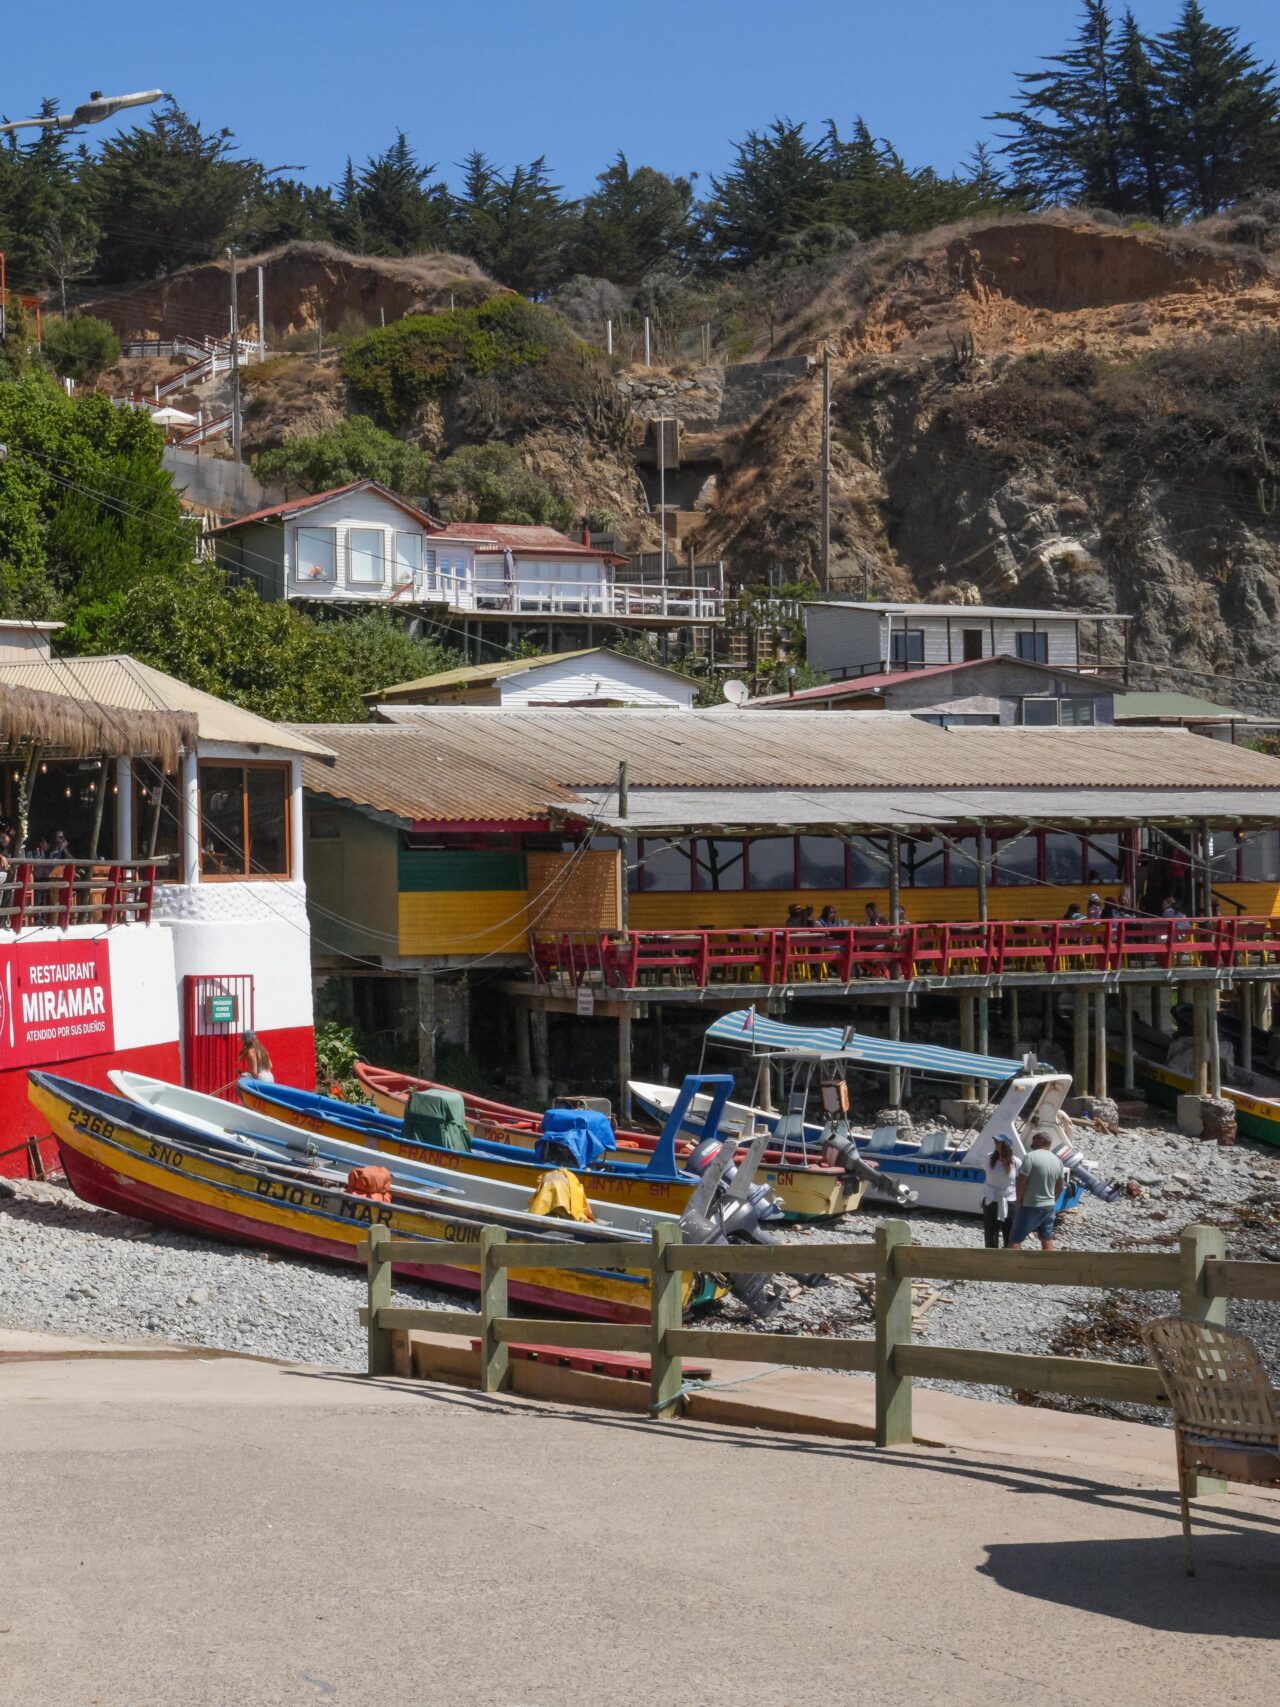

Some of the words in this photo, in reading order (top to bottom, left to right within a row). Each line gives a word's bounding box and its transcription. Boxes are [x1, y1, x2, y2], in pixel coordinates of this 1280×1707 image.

[29, 962, 95, 984] RESTAURANT
[22, 986, 105, 1024] MIRAMAR
[26, 1028, 57, 1042] ATENDIDO
[57, 1026, 70, 1037] POR
[70, 1024, 82, 1036] SUS
[83, 1019, 106, 1034] DUEÑOS
[68, 1107, 115, 1139] 2368
[777, 1171, 794, 1186] GN
[918, 1164, 979, 1180] QUINTAY
[649, 1183, 670, 1197] SM
[340, 1199, 393, 1228] MAR
